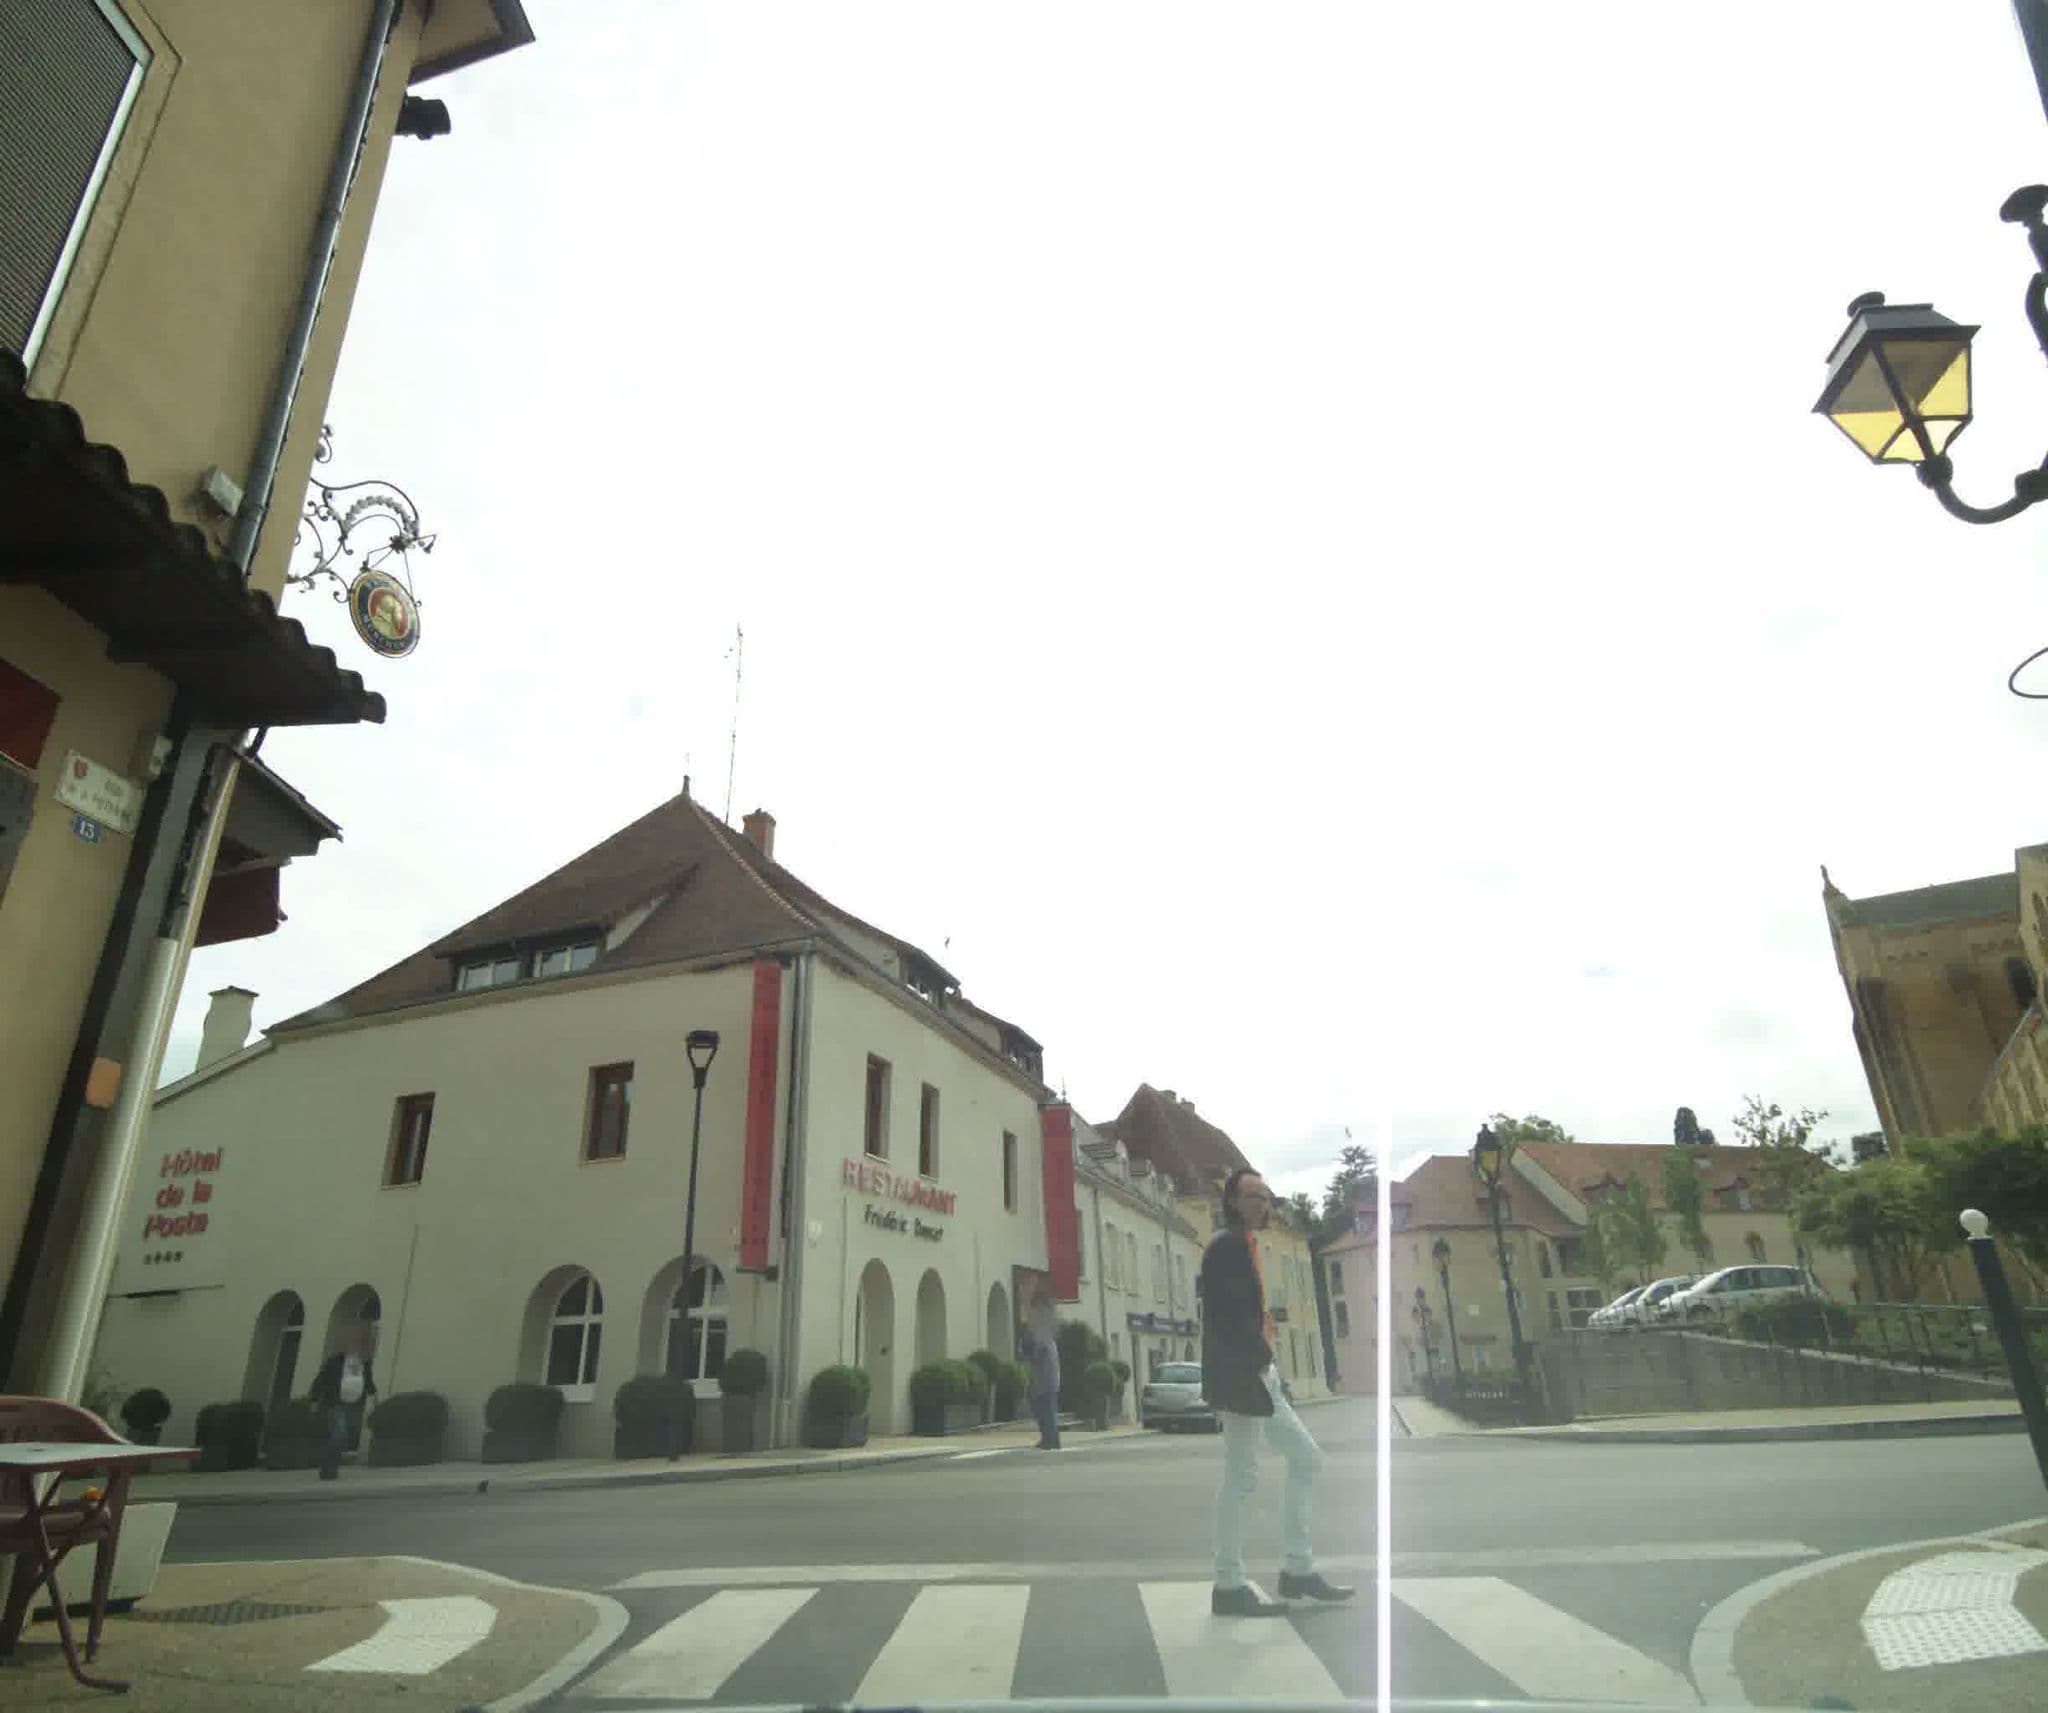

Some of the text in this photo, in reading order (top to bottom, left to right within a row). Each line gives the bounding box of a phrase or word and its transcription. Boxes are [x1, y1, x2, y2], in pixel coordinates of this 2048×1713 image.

[160, 1146, 222, 1178] Hôtel
[156, 1179, 213, 1208] de la
[842, 1157, 957, 1218] RESTAURANT
[143, 1211, 209, 1241] Poste
